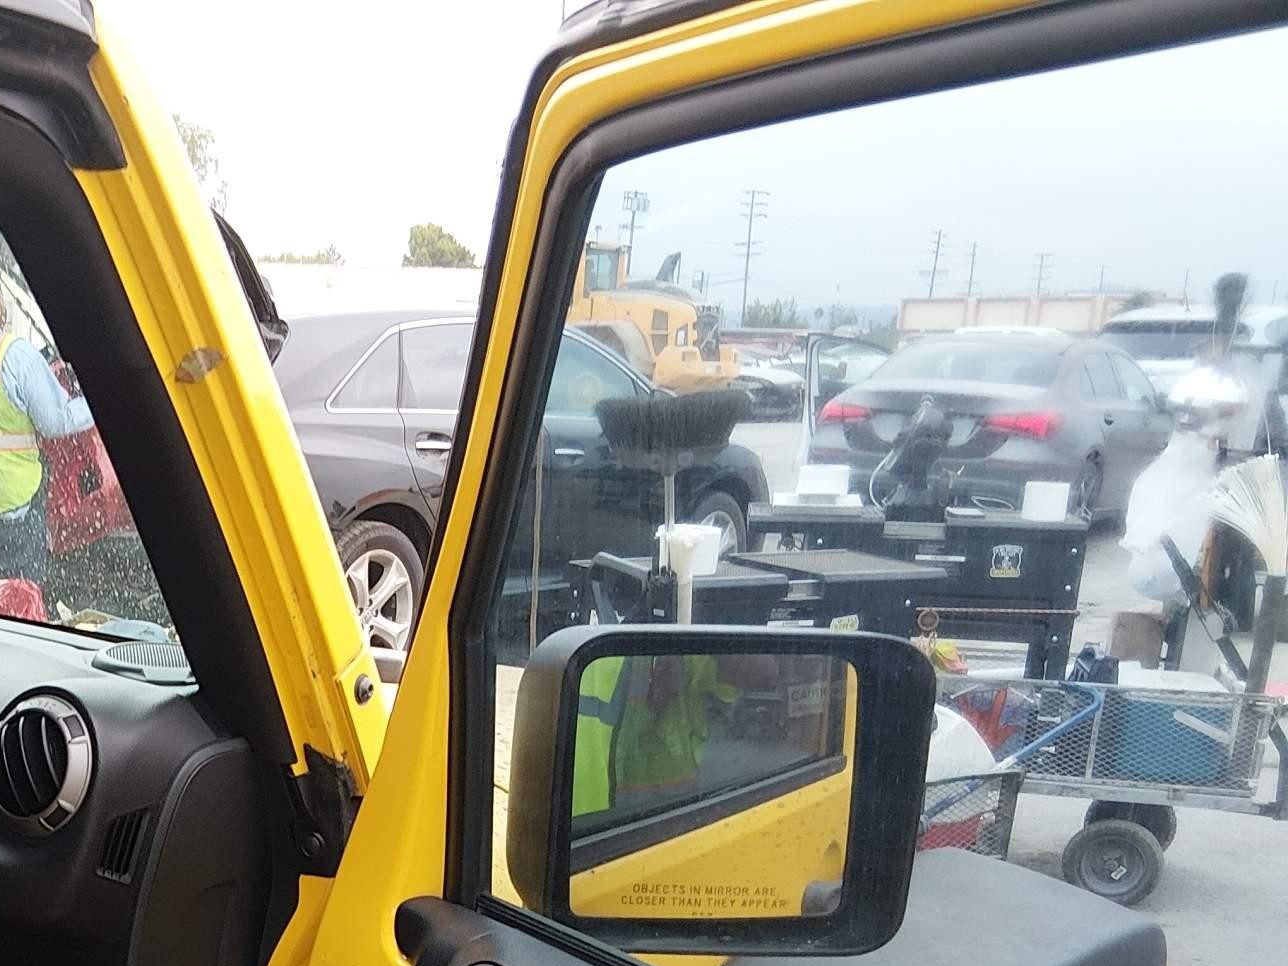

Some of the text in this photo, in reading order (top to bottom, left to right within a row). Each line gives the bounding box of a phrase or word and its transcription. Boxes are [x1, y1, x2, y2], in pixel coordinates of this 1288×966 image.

[632, 882, 779, 898] OBJECTS IN MIRROR ARE
[620, 895, 789, 910] CLOSER THAN THEY APPEAR
